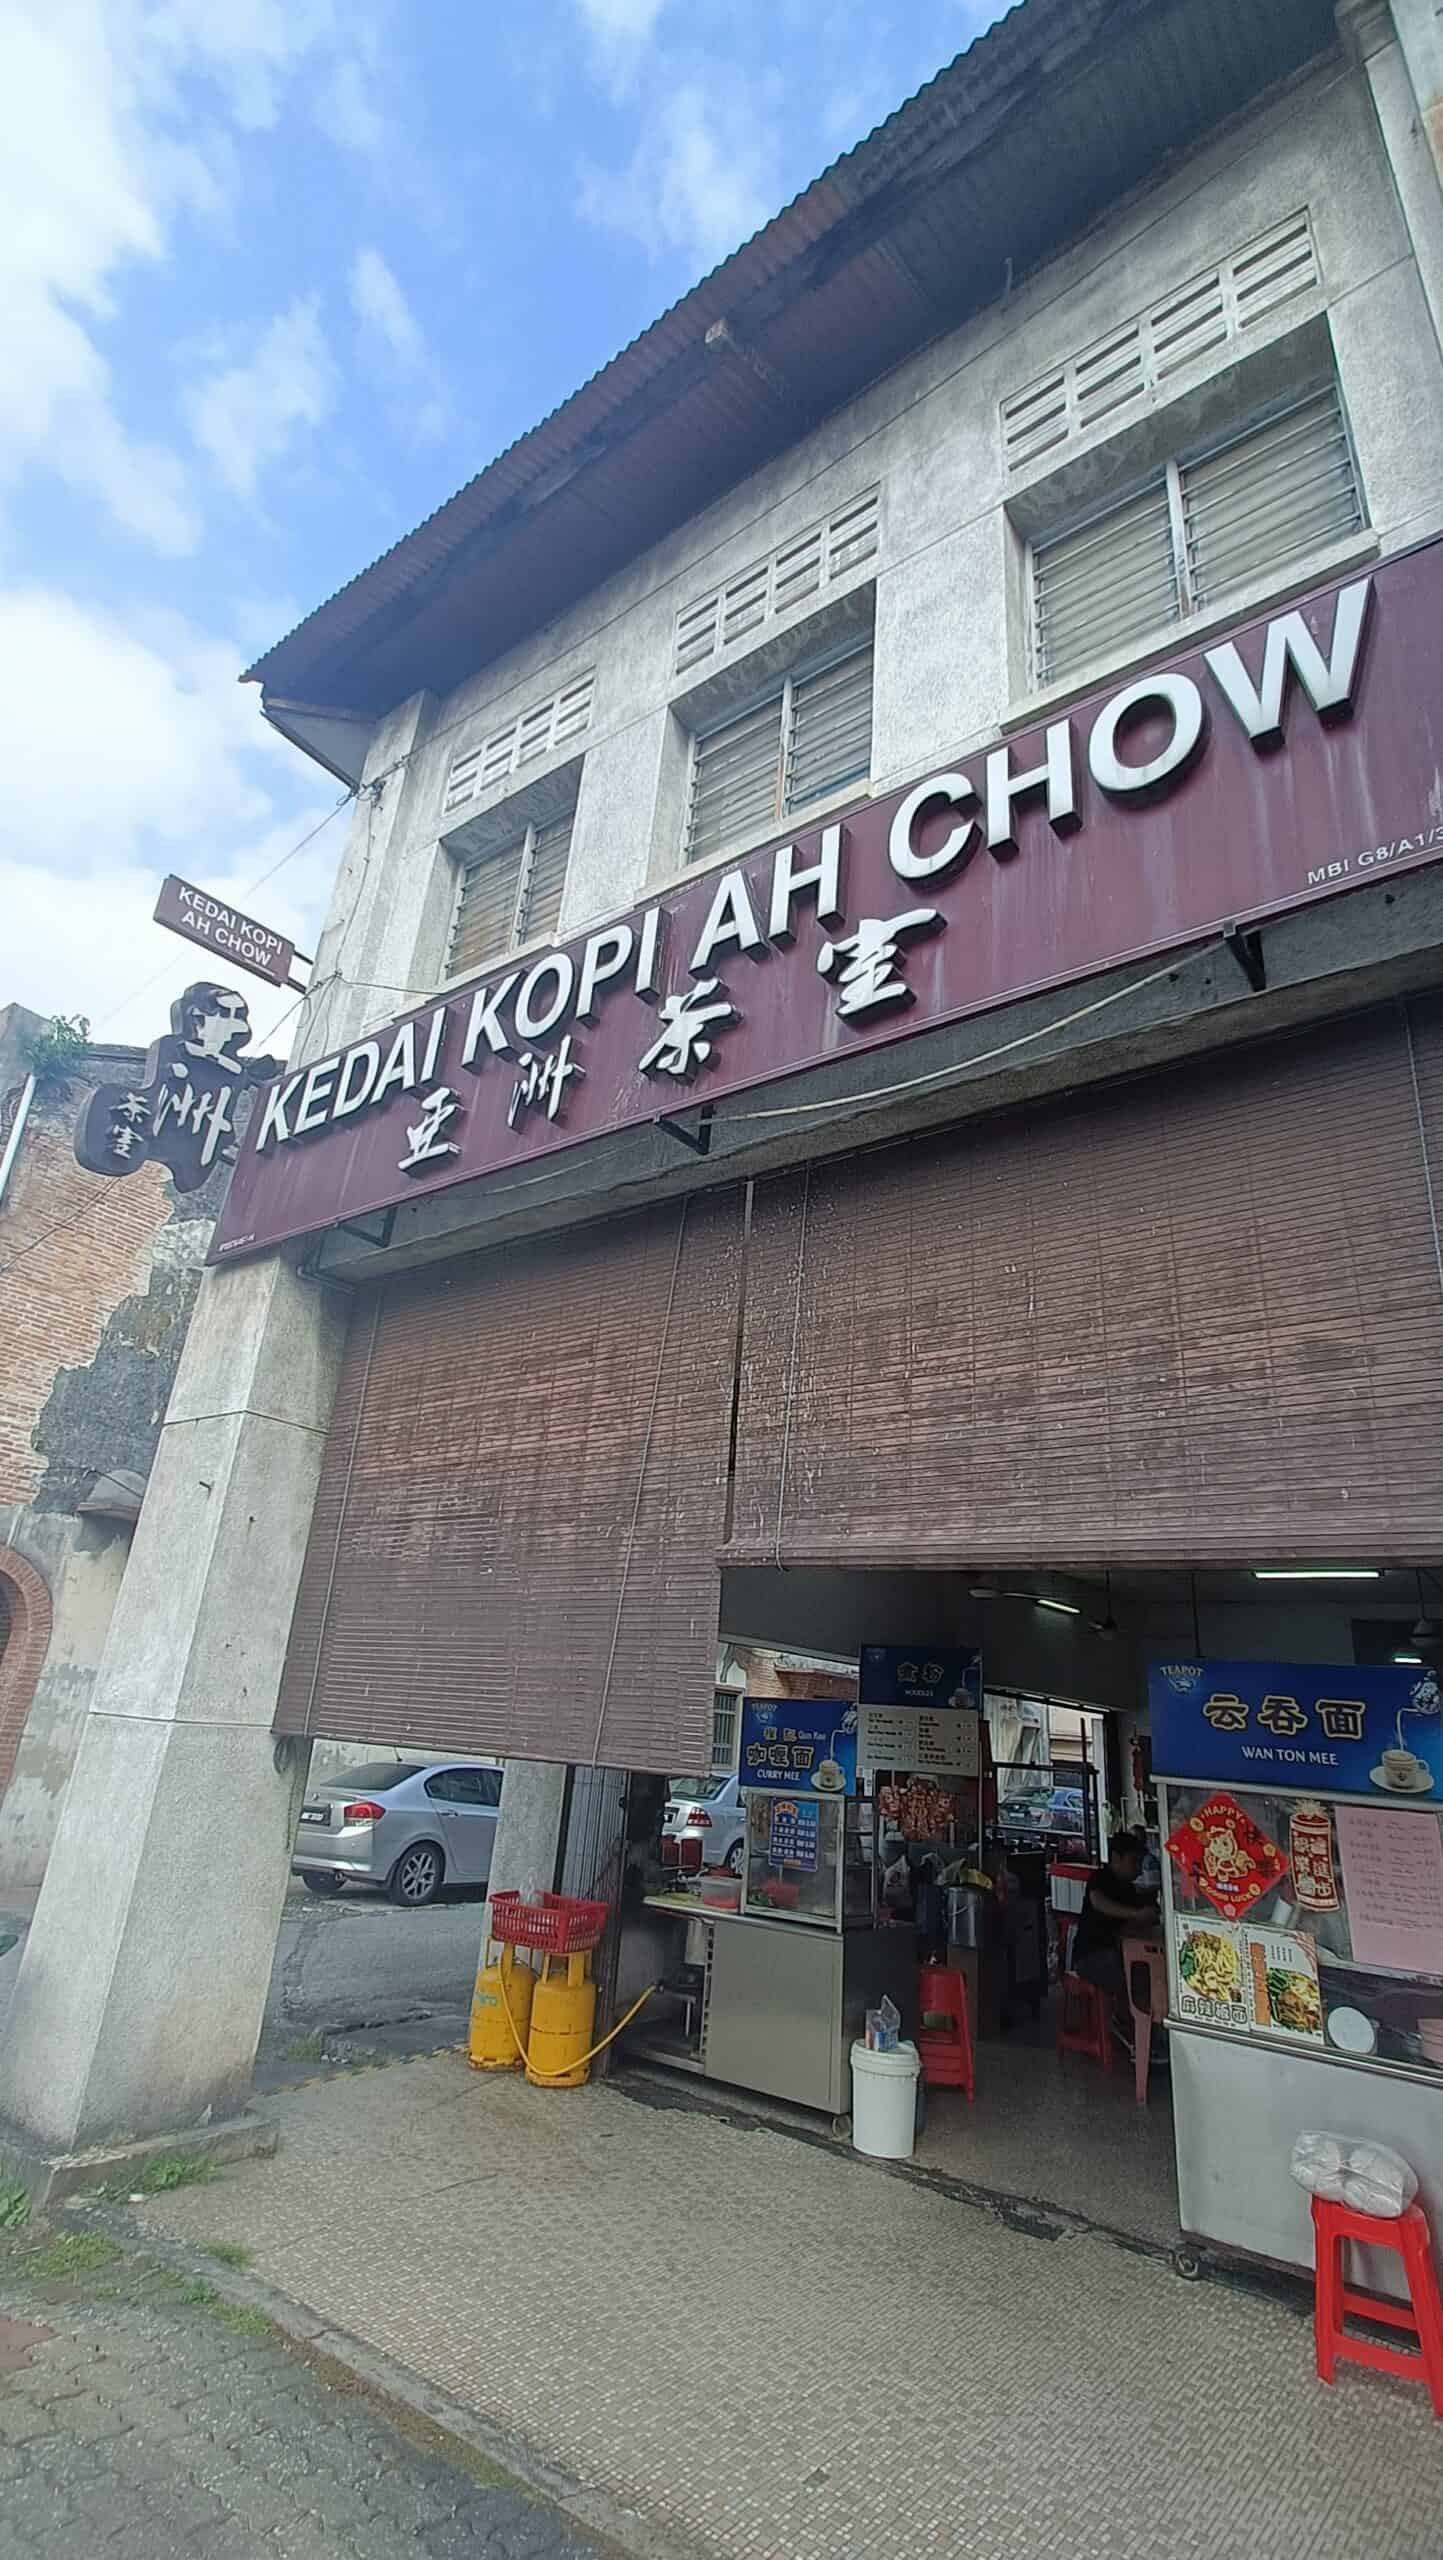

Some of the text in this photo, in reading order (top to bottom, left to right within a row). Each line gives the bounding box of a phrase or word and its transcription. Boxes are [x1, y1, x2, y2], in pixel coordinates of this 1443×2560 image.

[256, 576, 1376, 1153] KEDAI KOPI AH CHOW
[1307, 859, 1349, 884] MBI
[178, 886, 283, 954] KEDAI KOPI
[181, 911, 272, 966] AH CHOW
[1160, 1664, 1204, 1677] TEAPOT
[1203, 1693, 1366, 1740] 云吞面
[1241, 1745, 1339, 1766] WAN TON MEE
[757, 1769, 800, 1781] CURRY MEE
[1204, 1805, 1243, 1820] HAPPY
